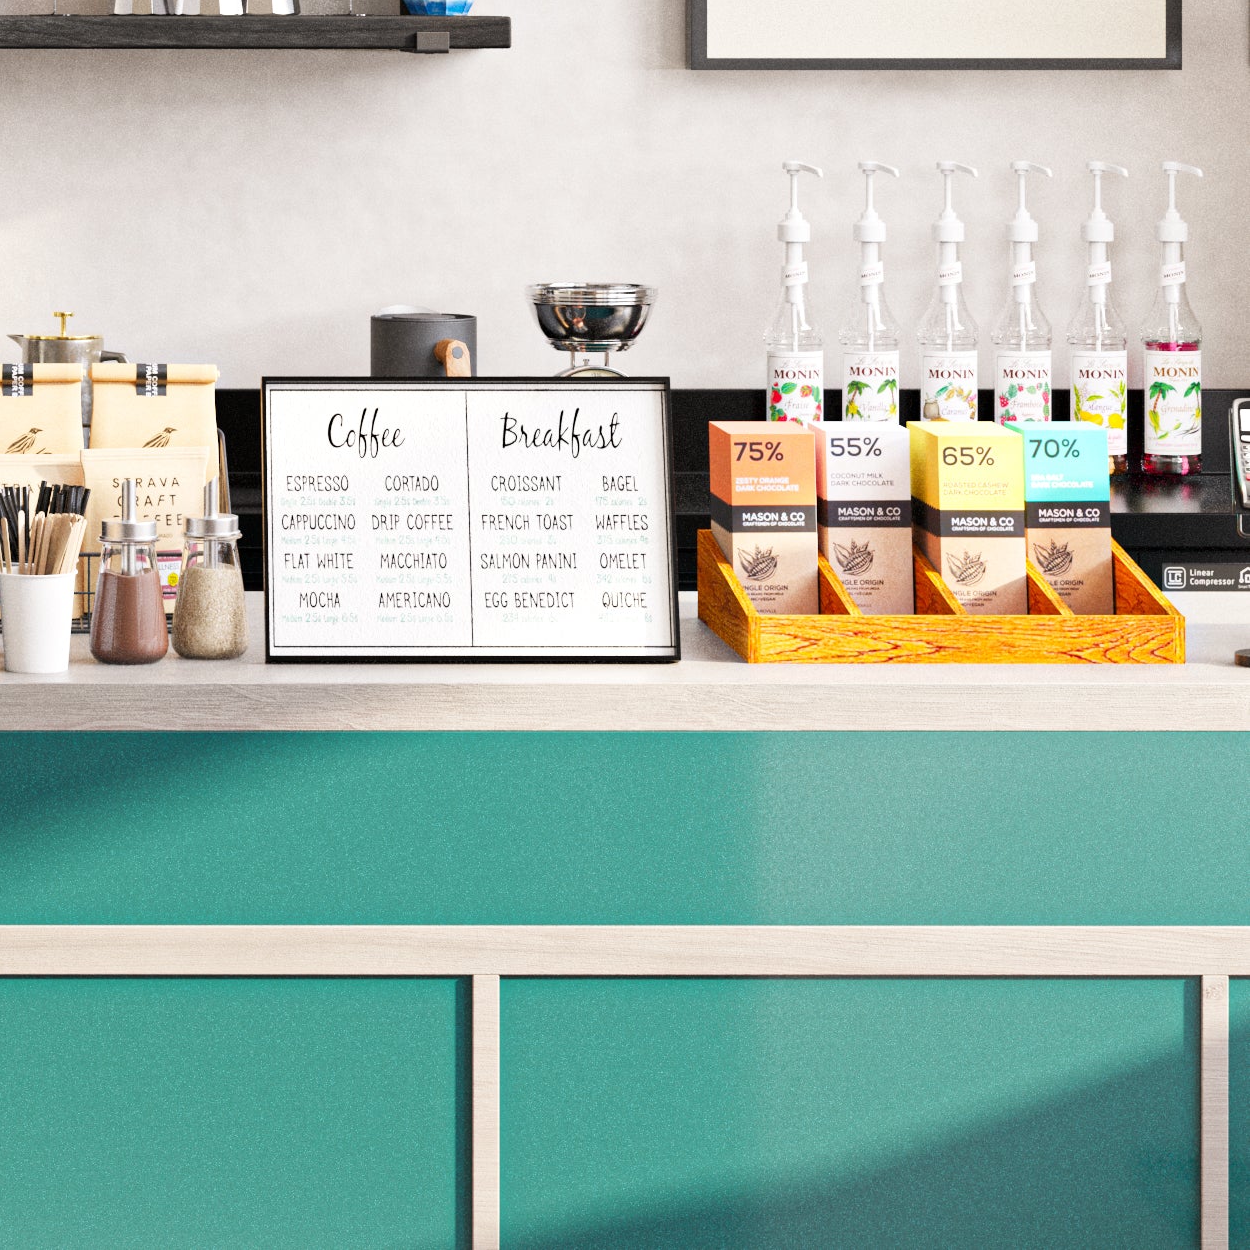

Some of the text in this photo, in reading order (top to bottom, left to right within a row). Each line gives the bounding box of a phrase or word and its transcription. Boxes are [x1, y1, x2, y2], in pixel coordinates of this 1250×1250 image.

[774, 369, 820, 379] MONIN
[849, 367, 896, 376] MONIN
[929, 369, 974, 379] MONIN
[1003, 369, 1049, 379] MONIN
[1078, 369, 1125, 379] MONIN
[1153, 366, 1199, 377] MONIN
[328, 407, 406, 458] Coffee
[500, 407, 622, 458] Breakfast
[734, 441, 784, 461] 75%
[830, 437, 882, 456] 55%
[1029, 439, 1080, 458] 70%
[943, 446, 994, 466] 65%
[286, 475, 349, 492] ESPRESSO
[385, 475, 439, 492] CORTADO
[491, 475, 561, 492] CROISSANT
[602, 475, 638, 492] BAGEL
[736, 484, 799, 492] DARK CHOCOLATE
[742, 512, 805, 521] MASON & CO
[838, 507, 901, 516] MASON & CO
[1038, 509, 1100, 517] MASON & CO
[281, 513, 356, 530] CAPPUCCINO
[372, 514, 453, 530] DRIP COFFEE
[481, 514, 573, 531] FRENCH TOAST
[595, 514, 649, 531] WAFFLES
[951, 517, 1014, 526] MASON & CO
[284, 553, 354, 569] FLAT WHITE
[380, 552, 447, 569] MACCHIATO
[480, 552, 577, 570] SALMON PANINI
[600, 552, 646, 569] OMELET
[1190, 578, 1234, 586] Compressor
[299, 591, 341, 608] MOCHA
[378, 591, 451, 608] AMERICANO
[484, 592, 575, 608] EGG BENEDICT
[602, 592, 648, 609] QUICHE
